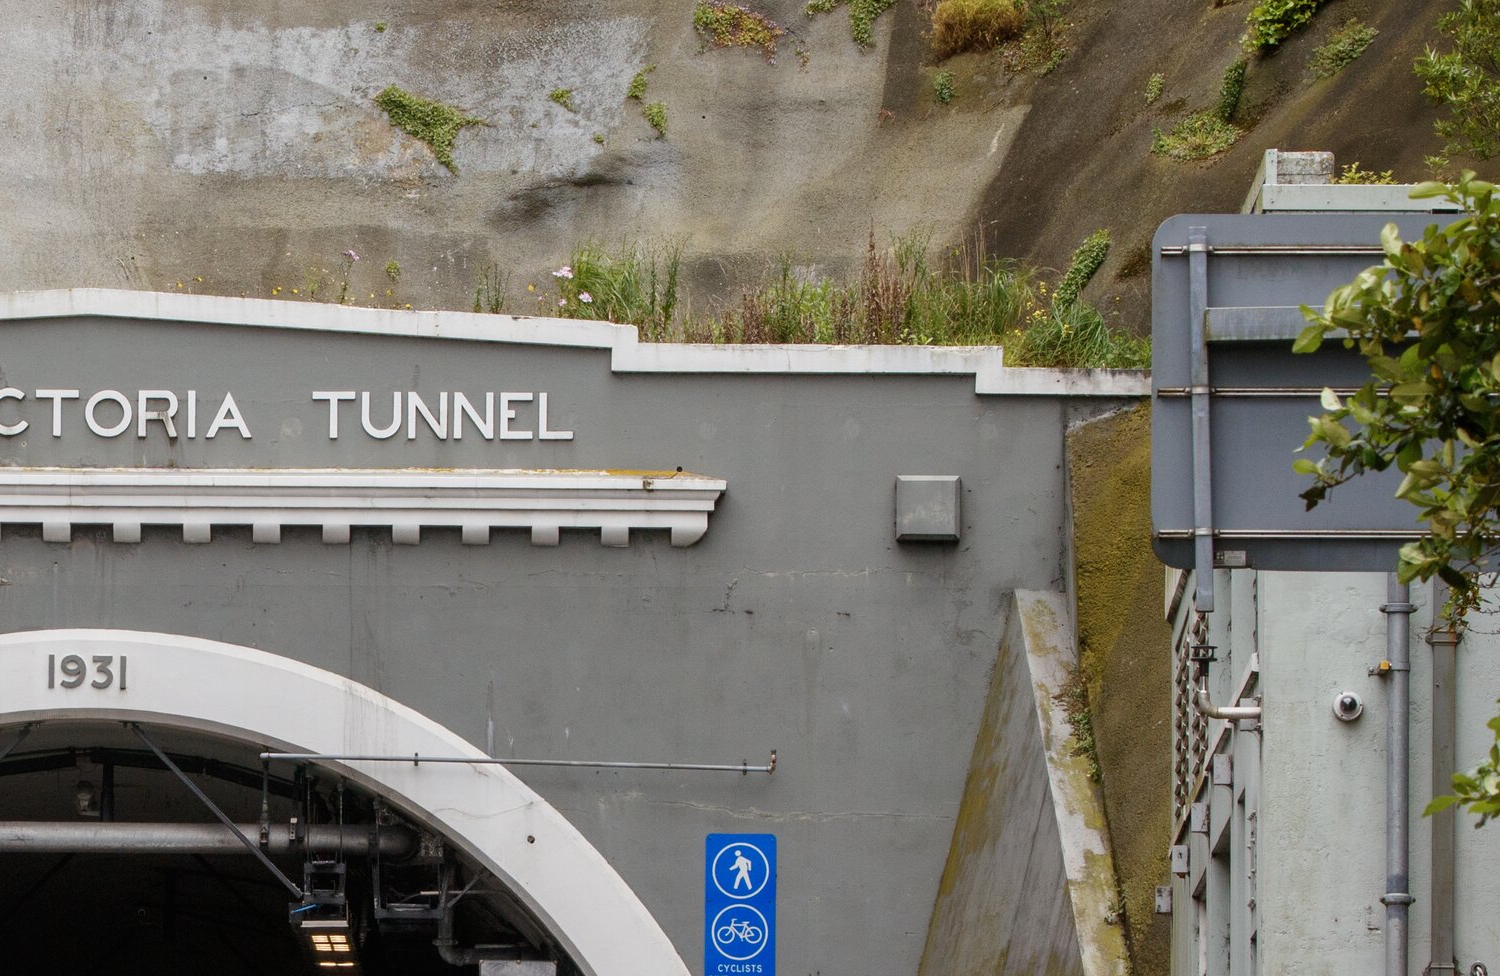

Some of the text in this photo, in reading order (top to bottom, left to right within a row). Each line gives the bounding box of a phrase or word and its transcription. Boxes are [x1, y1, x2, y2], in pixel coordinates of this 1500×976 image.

[312, 391, 574, 441] TUNNEL
[48, 654, 127, 690] 1931
[717, 964, 763, 973] CYCLISTS
